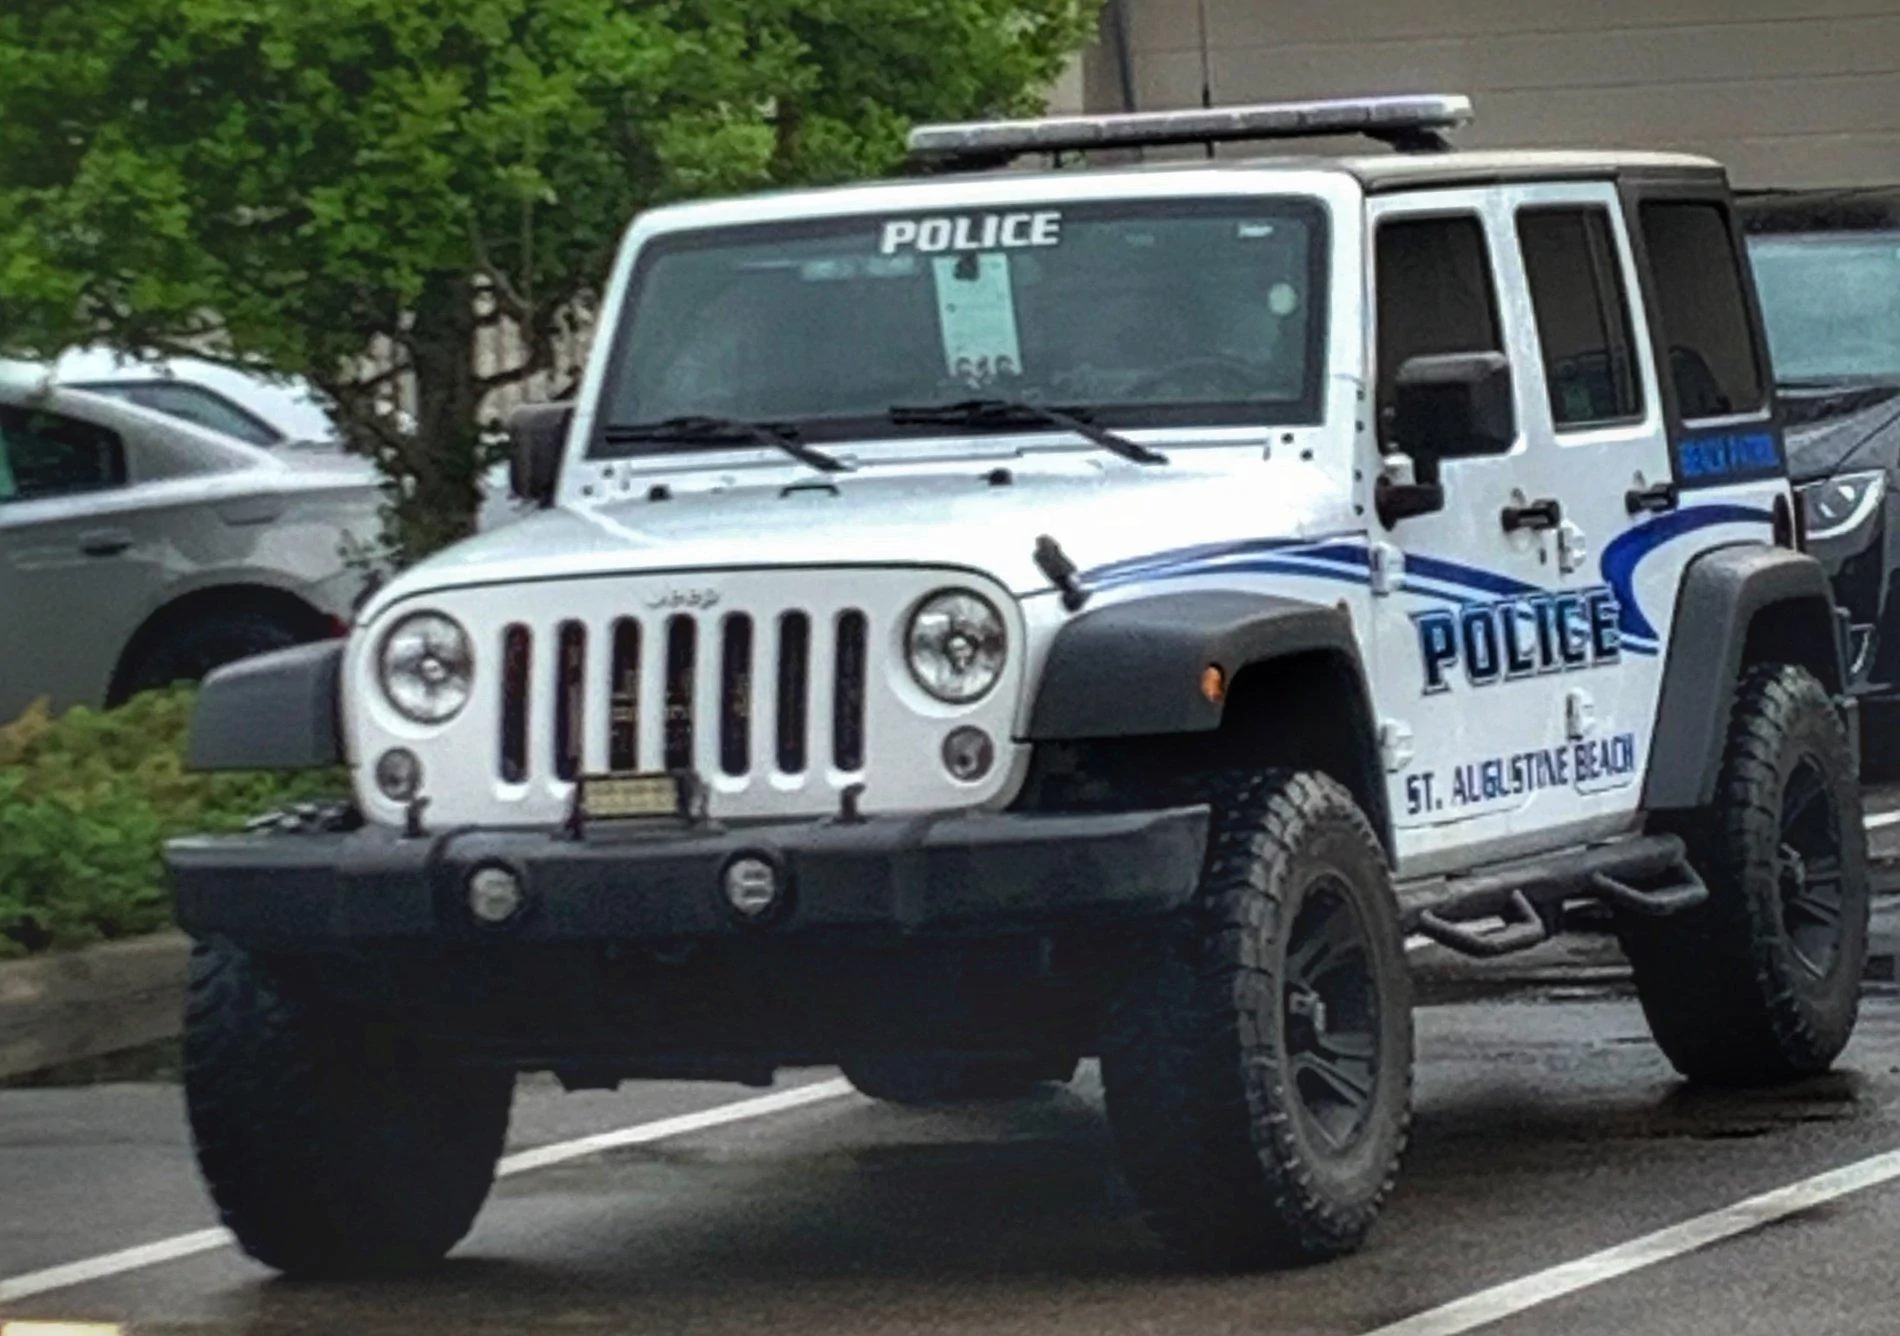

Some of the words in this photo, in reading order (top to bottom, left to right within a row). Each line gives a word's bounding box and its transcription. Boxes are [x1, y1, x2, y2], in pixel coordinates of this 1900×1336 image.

[882, 211, 1062, 254] POLICE
[1409, 580, 1621, 696] POLICE
[1406, 772, 1443, 815] ST.
[1452, 746, 1569, 805] AUGUSTINE
[1574, 732, 1636, 782] BEACH
